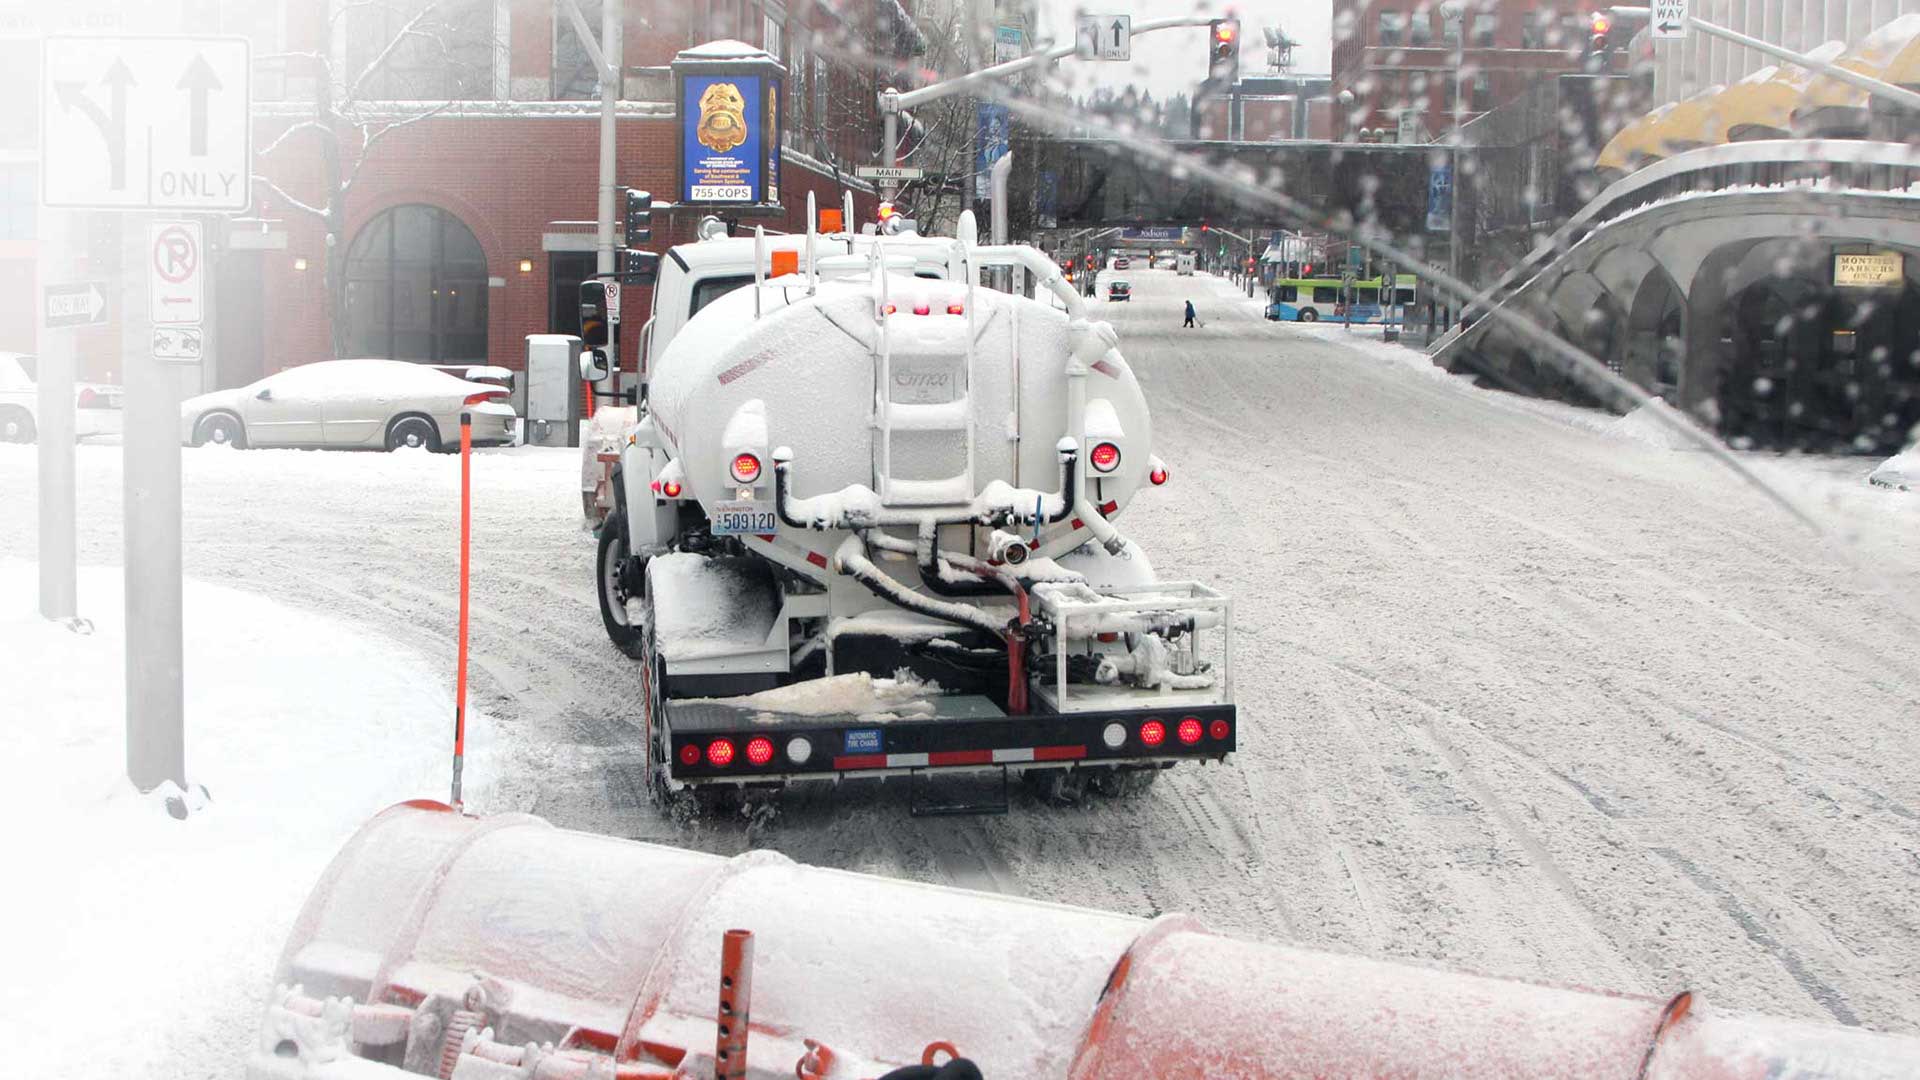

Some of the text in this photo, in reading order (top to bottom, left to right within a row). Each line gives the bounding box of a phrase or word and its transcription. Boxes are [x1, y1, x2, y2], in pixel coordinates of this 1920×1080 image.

[1657, 8, 1683, 19] WAY
[160, 171, 238, 197] ONLY
[694, 188, 748, 198] 755-COPS
[52, 296, 69, 314] ONE
